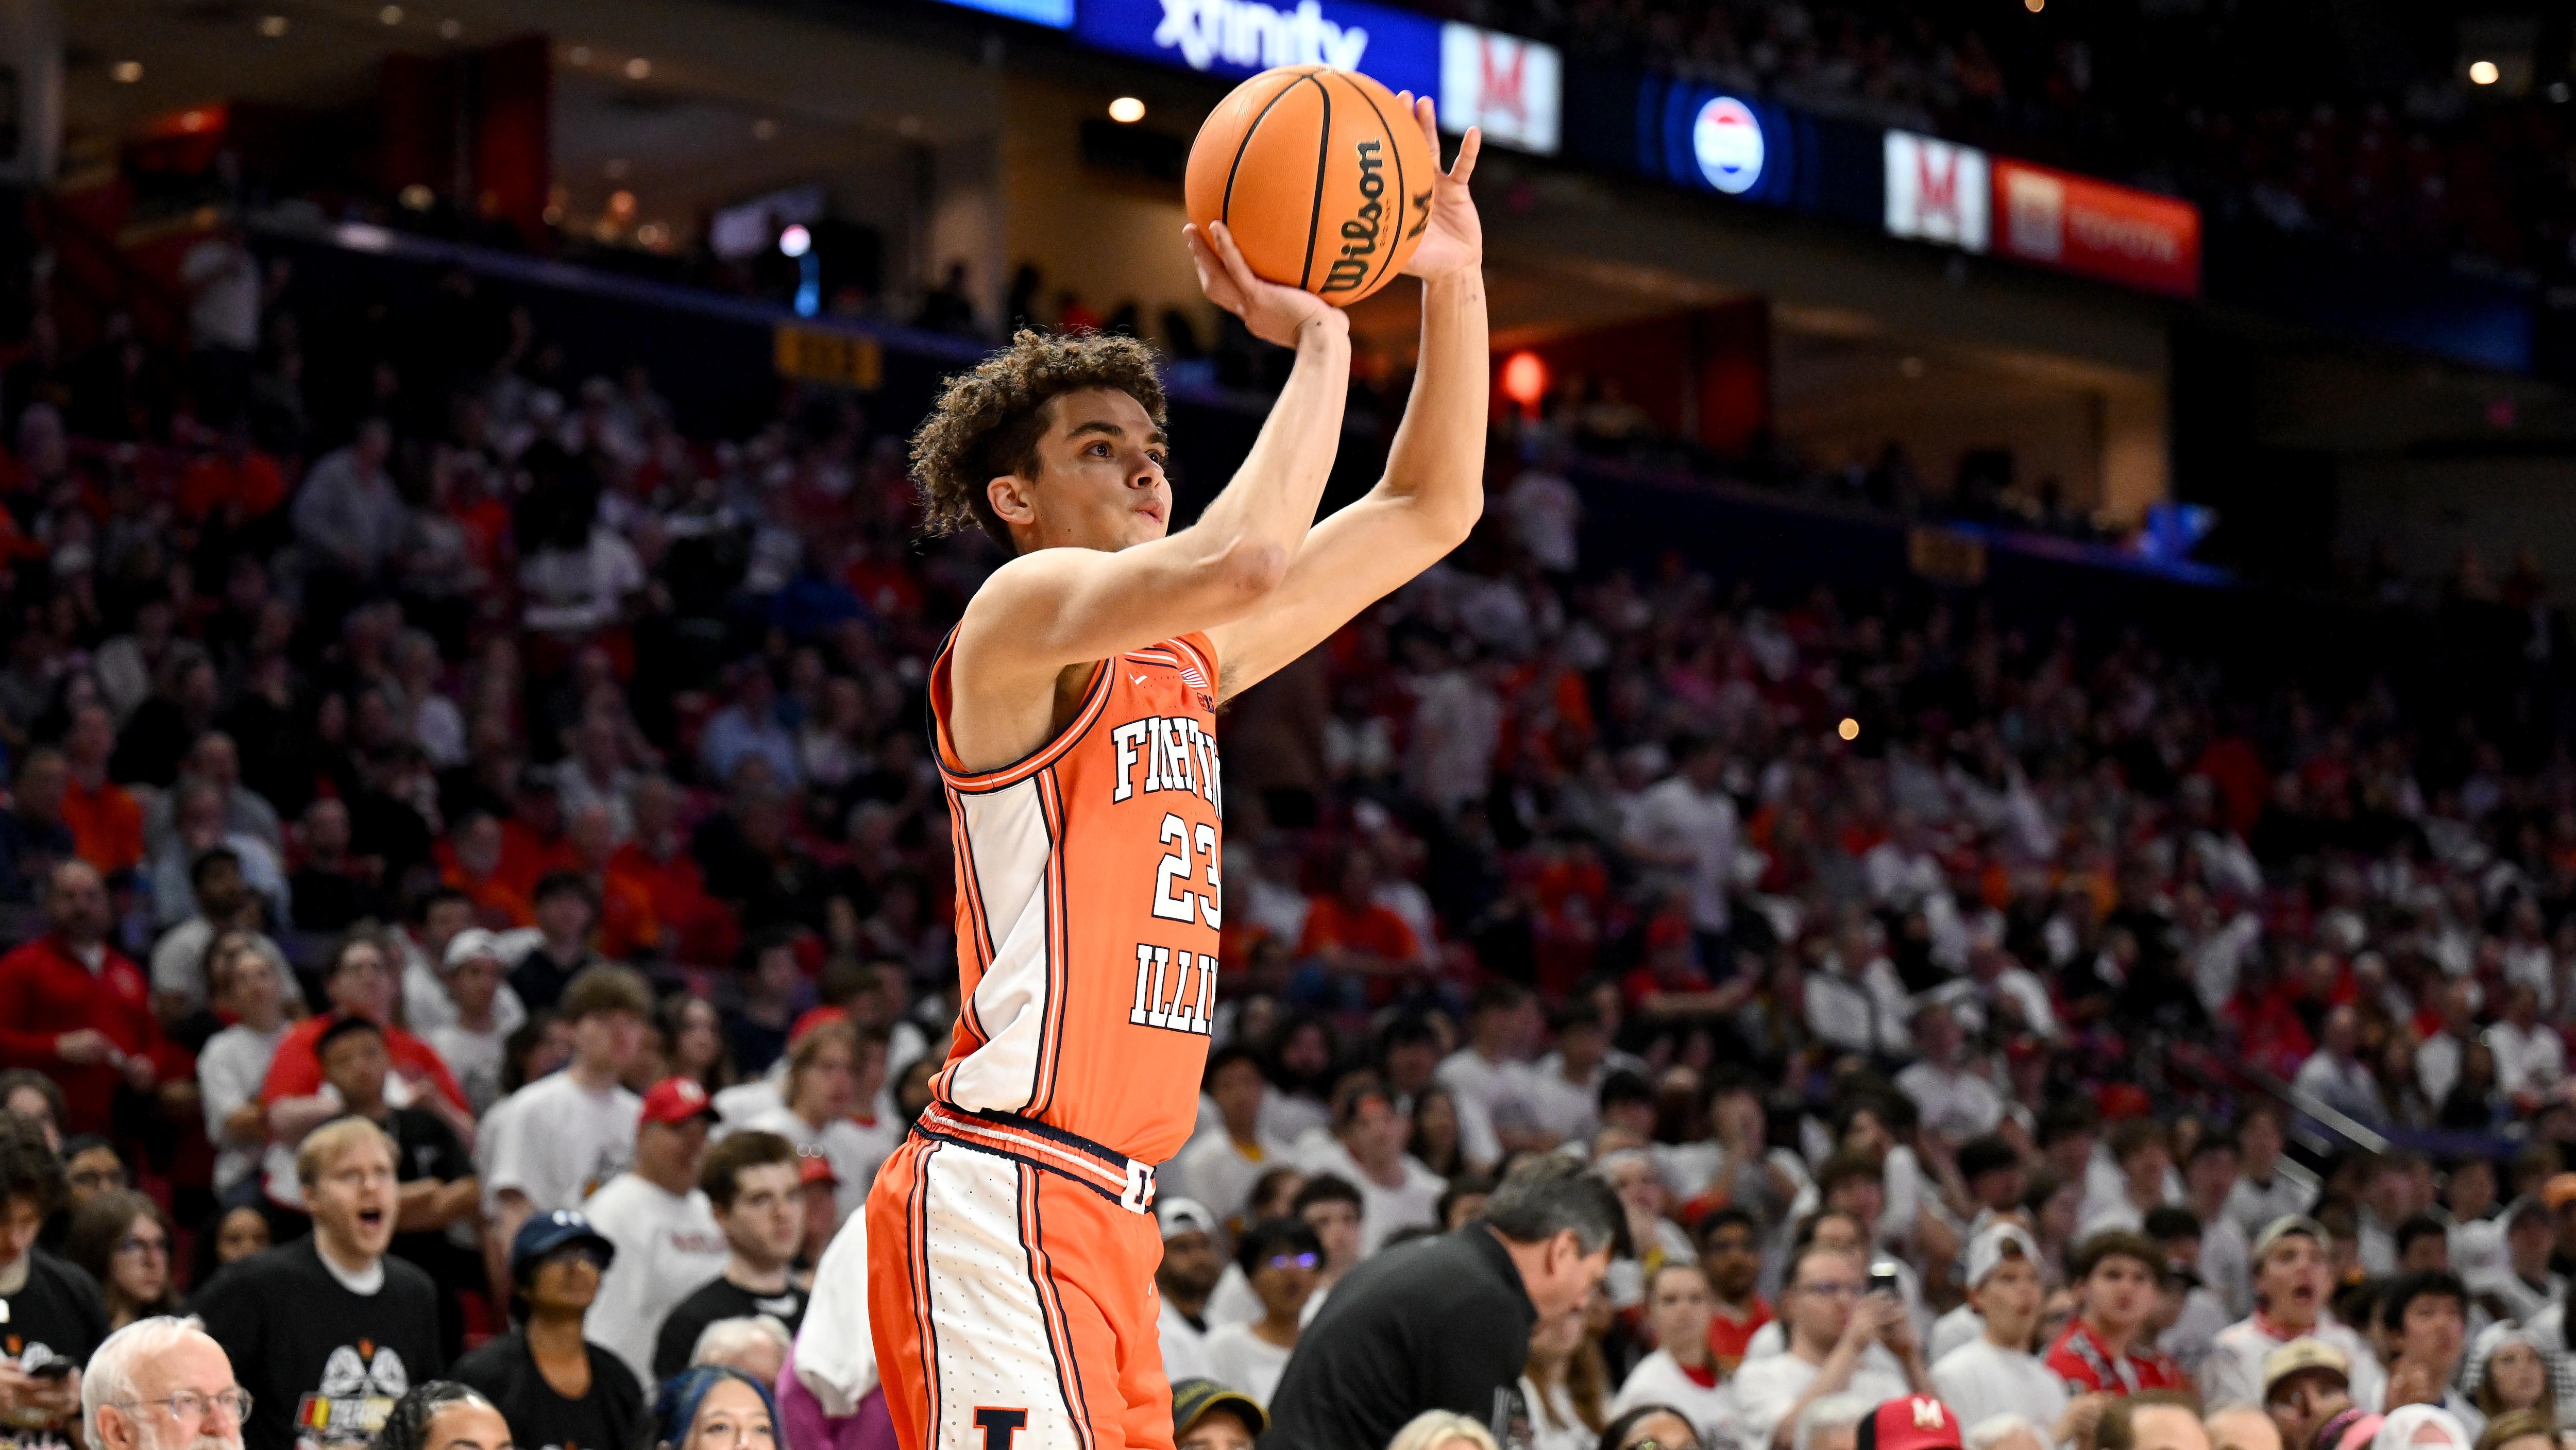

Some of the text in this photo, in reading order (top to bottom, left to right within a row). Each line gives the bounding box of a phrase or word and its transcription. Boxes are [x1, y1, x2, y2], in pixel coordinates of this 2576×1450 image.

[1318, 138, 1384, 293] Wilson
[1151, 811, 1221, 931] 23
[1128, 943, 1219, 1037] ILLI
[1911, 1396, 1945, 1428] M
